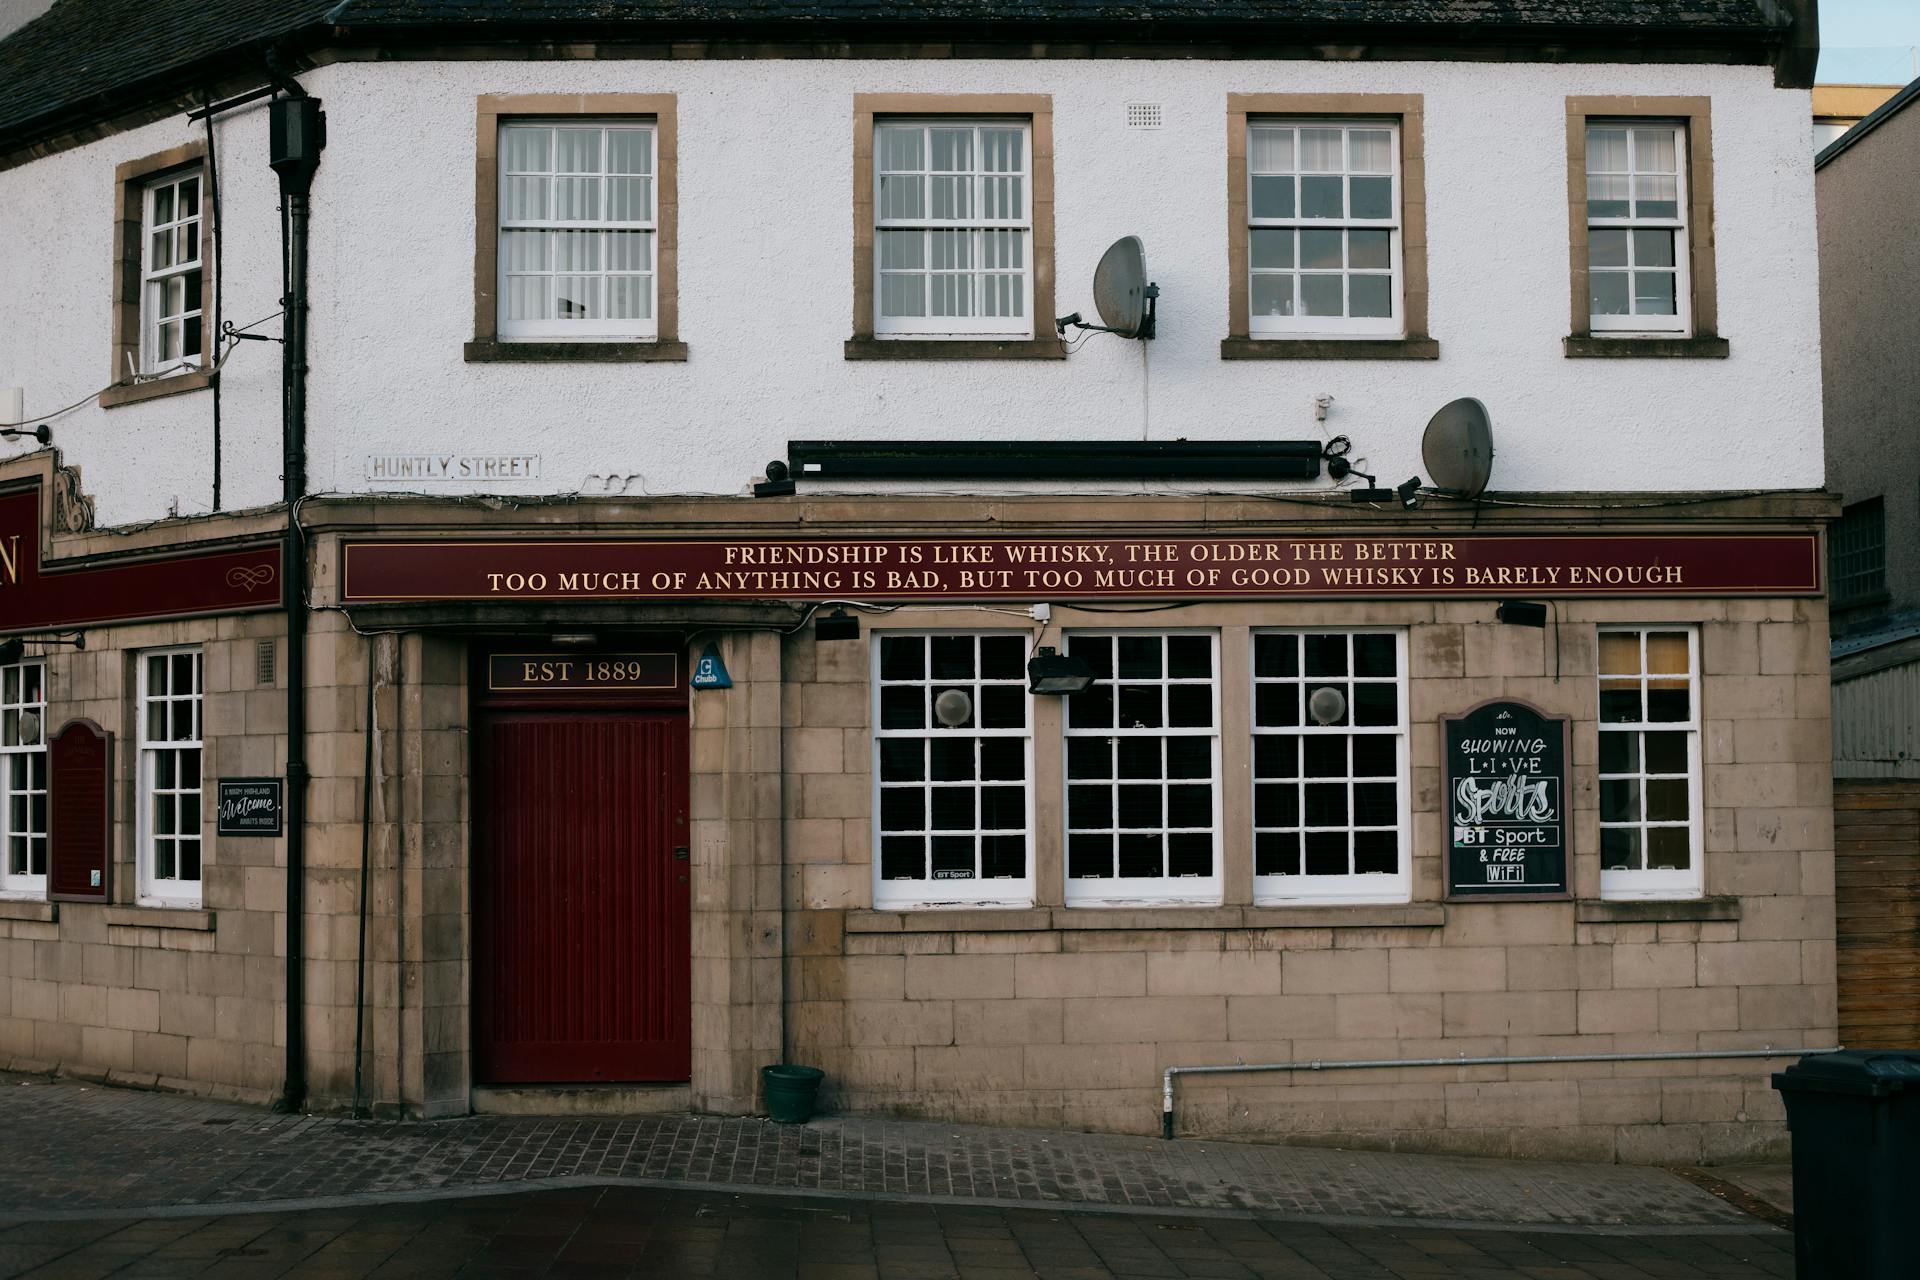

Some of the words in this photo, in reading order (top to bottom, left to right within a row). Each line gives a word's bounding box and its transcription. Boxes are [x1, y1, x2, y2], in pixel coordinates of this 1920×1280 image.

[373, 457, 449, 477] HUNTLY
[459, 457, 534, 477] STREET
[725, 546, 888, 564] FRIENDSHIP
[899, 546, 923, 563] IS
[934, 546, 994, 563] LIKE
[1004, 545, 1114, 565] WHISKY,
[1125, 545, 1179, 562] THE
[1190, 544, 1281, 562] OLDER
[1290, 544, 1344, 560] THE
[1355, 543, 1456, 560] BETTER
[488, 573, 547, 591] TOO
[558, 572, 641, 590] MUCH
[651, 572, 687, 589] OF
[696, 571, 842, 589] ANYTHING
[852, 571, 876, 588] IS
[887, 571, 948, 591] BAD,
[960, 571, 1013, 588] BUT
[1024, 570, 1083, 588] TOO
[1094, 569, 1175, 587] MUCH
[1186, 569, 1221, 586] OF
[1231, 568, 1311, 586] GOOD
[1321, 567, 1423, 585] WHISKY
[1432, 567, 1455, 584] IS
[1465, 566, 1561, 584] BARELY
[1569, 566, 1683, 583] ENOUGH
[523, 662, 573, 681] EST
[585, 661, 641, 681] 1889
[695, 674, 717, 683] Chubb
[1495, 727, 1517, 735] NOW
[1460, 738, 1547, 754] SHOWING
[243, 787, 271, 795] HIGHLAND
[1455, 773, 1555, 826] Sports
[222, 797, 275, 820] Welcome
[1463, 828, 1489, 844] BT
[1495, 828, 1546, 846] Sport
[1479, 849, 1488, 862] &
[1492, 848, 1525, 862] FREE
[950, 871, 971, 879] Sport
[1488, 866, 1520, 881] WiFi
